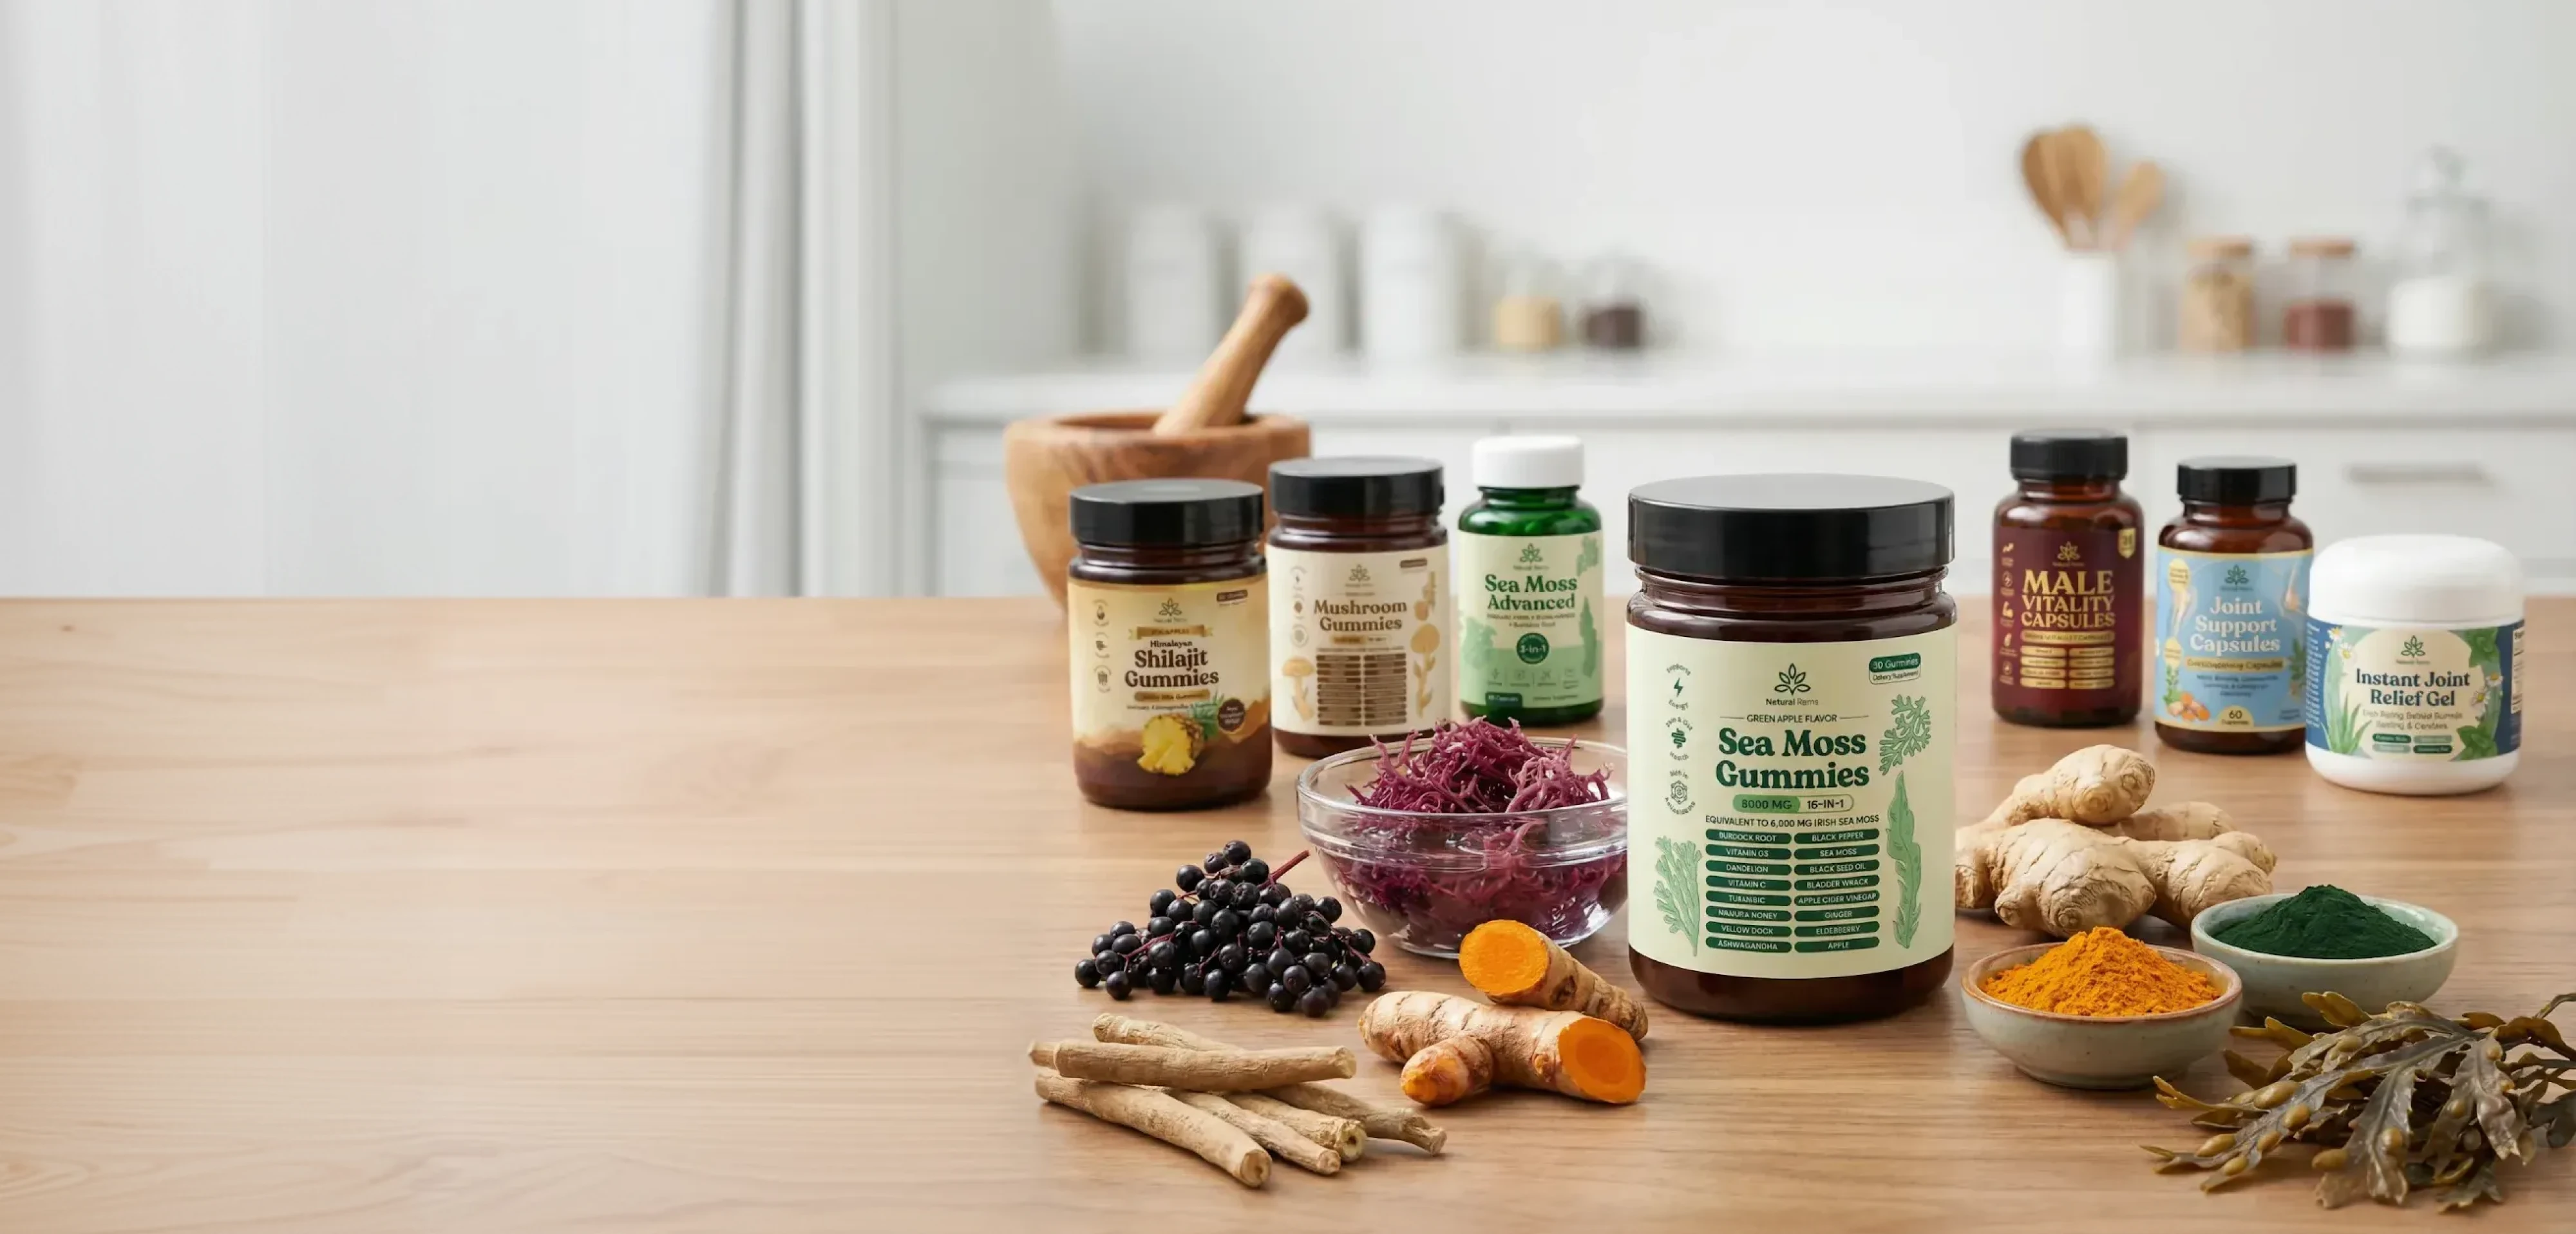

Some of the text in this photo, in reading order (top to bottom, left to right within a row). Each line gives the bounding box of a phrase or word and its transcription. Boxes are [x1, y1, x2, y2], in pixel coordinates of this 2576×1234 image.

[1484, 574, 1577, 593] Sea Moss
[2022, 569, 2114, 594] MALE
[1314, 599, 1407, 615] Mushroom
[1487, 592, 1575, 611] Advanced
[2022, 594, 2115, 612] VITALITY
[2209, 596, 2263, 615] Joint
[1320, 616, 1402, 632] Gummies
[2021, 612, 2116, 629] CAPSULES
[2195, 614, 2277, 638] Support
[1150, 640, 1193, 649] Himalayan
[2190, 633, 2281, 656] Capsules
[1134, 647, 1209, 671] Shilajit
[1124, 668, 1219, 688] Gummies
[2356, 668, 2470, 687] Instant Joint
[2370, 688, 2455, 707] Relief Gel
[1747, 714, 1775, 723] GREEN
[1805, 714, 1837, 723] FLAVOR
[2228, 710, 2242, 719] 60
[1718, 728, 1866, 756] Sea Moss
[1716, 760, 1870, 789] Gummies
[1772, 800, 1792, 810] MG
[1806, 799, 1844, 810] 16-IN-1
[1705, 815, 1755, 826] EQUIVALENT
[1756, 819, 1768, 827] TO
[1770, 819, 1795, 828] 6,000
[1814, 818, 1836, 827] IRISH
[1856, 815, 1879, 824] MOSS
[1812, 833, 1836, 842] BLACK
[1725, 848, 1757, 857] VITAMIN
[1726, 864, 1768, 873] DANDELION
[1728, 879, 1759, 888] VITAMIN
[1718, 940, 1778, 950] ASHWAGANDHA
[1828, 941, 1850, 949] APPLE
